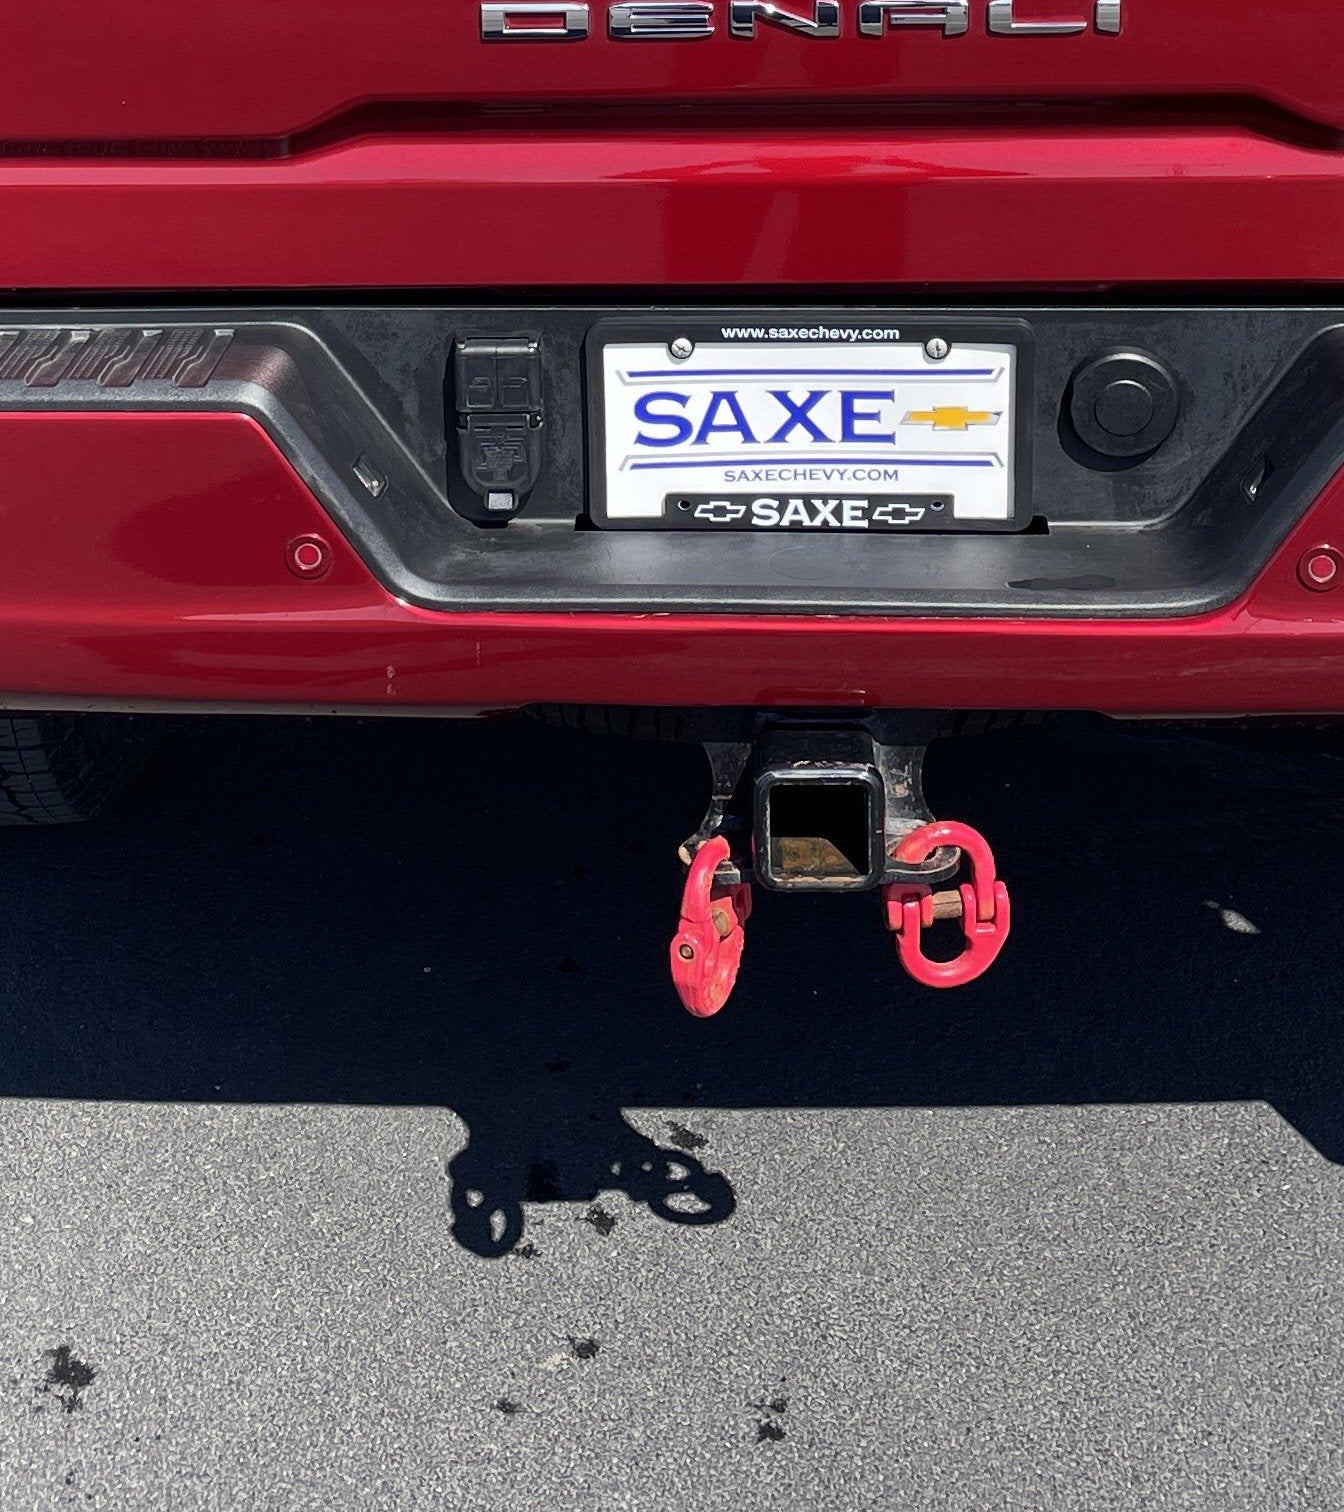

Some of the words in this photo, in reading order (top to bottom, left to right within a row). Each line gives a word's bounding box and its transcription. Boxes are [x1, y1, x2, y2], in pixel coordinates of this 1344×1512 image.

[720, 325, 900, 342] www.saxechevy.com
[633, 390, 897, 448] SAXE
[723, 468, 899, 483] SAXECHEVY.COM
[750, 498, 869, 529] SAXE
